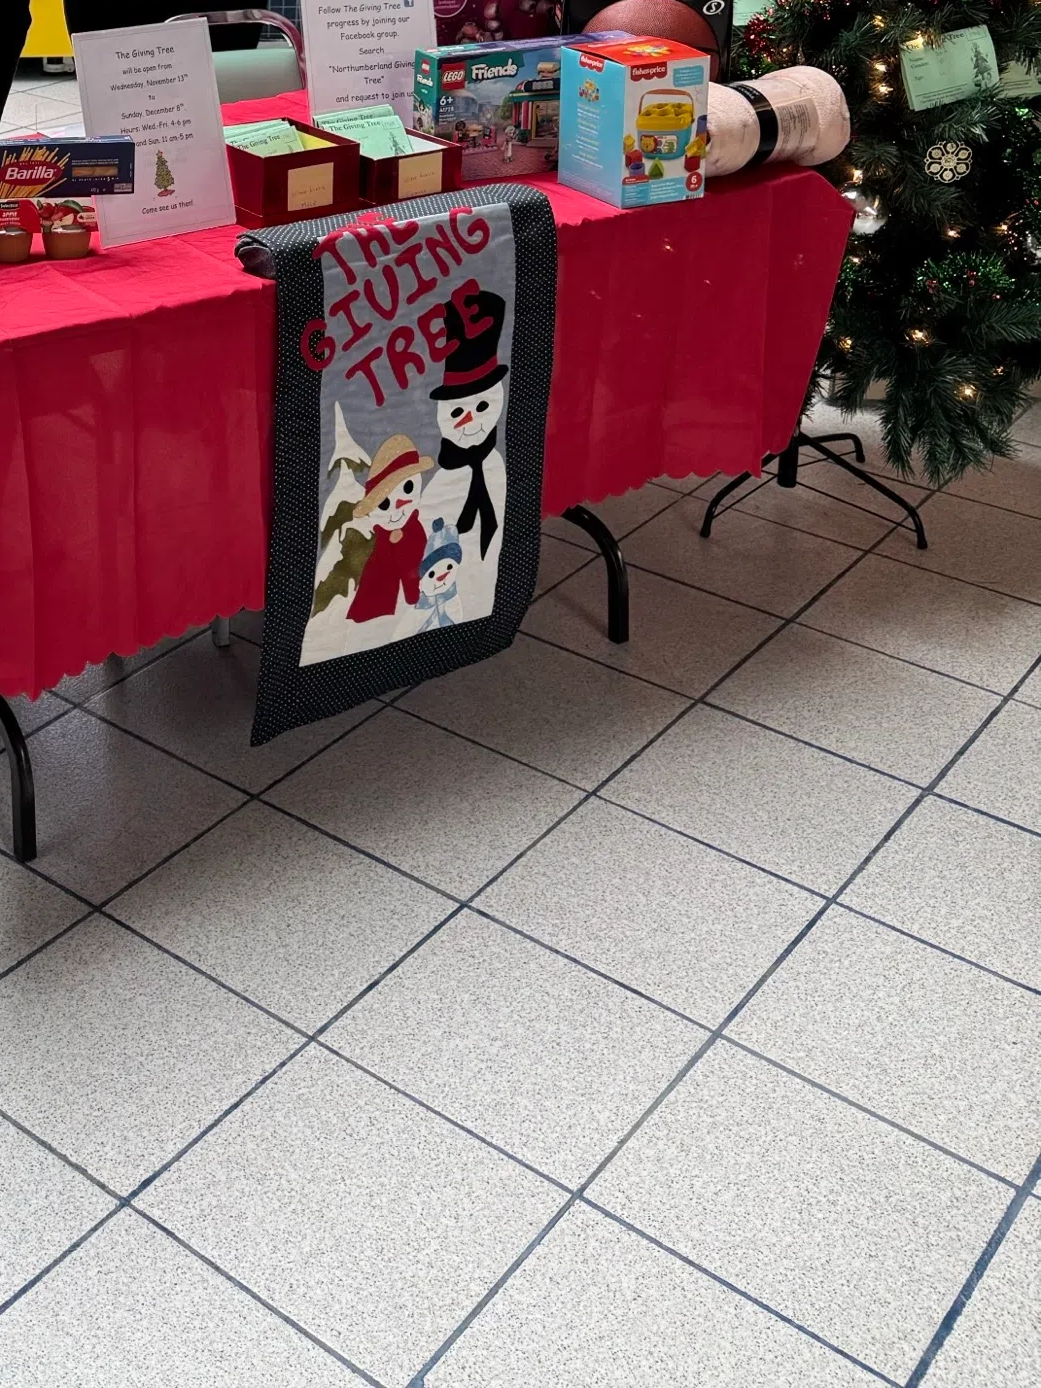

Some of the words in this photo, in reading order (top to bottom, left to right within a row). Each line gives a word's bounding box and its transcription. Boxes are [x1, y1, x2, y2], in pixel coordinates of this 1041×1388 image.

[318, 6, 341, 15] Follow
[344, 4, 358, 13] The
[359, 3, 382, 13] Giving
[383, 2, 401, 10] Tree
[326, 19, 360, 30] progress
[360, 17, 370, 27] by
[371, 16, 397, 27] joining
[397, 15, 411, 23] our
[340, 31, 375, 41] Facebook
[376, 31, 400, 41] group.
[948, 32, 965, 41] Tree
[115, 50, 131, 60] The
[132, 48, 155, 59] Giving
[156, 45, 175, 55] Tree
[358, 46, 385, 55] Search
[122, 67, 133, 75] will
[133, 66, 142, 74] be
[143, 64, 157, 73] open
[157, 62, 172, 71] from
[394, 60, 416, 70] Giving
[443, 70, 465, 83] LEGO
[471, 58, 518, 81] Friends
[110, 80, 146, 92] Wednesday,
[146, 76, 177, 87] November
[335, 94, 350, 103] and
[351, 93, 379, 103] request
[391, 91, 405, 100] join
[439, 96, 454, 107] 6+
[121, 111, 145, 121] Sunday,
[145, 106, 175, 117] December
[119, 125, 141, 135] Hours:
[182, 118, 192, 127] pm
[330, 124, 343, 132] The
[343, 122, 364, 131] Giving
[366, 119, 381, 128] Tree
[135, 137, 147, 147] and
[148, 136, 161, 146] Sun.
[185, 131, 195, 141] pm
[237, 142, 249, 151] The
[249, 137, 268, 148] Giving
[268, 133, 281, 143] Tree
[4, 167, 54, 181] Barilla
[690, 175, 697, 184] 6
[141, 205, 158, 215] Come
[158, 203, 170, 213] see
[170, 202, 178, 211] us
[300, 207, 491, 373] GIVING
[345, 278, 494, 407] TREE
